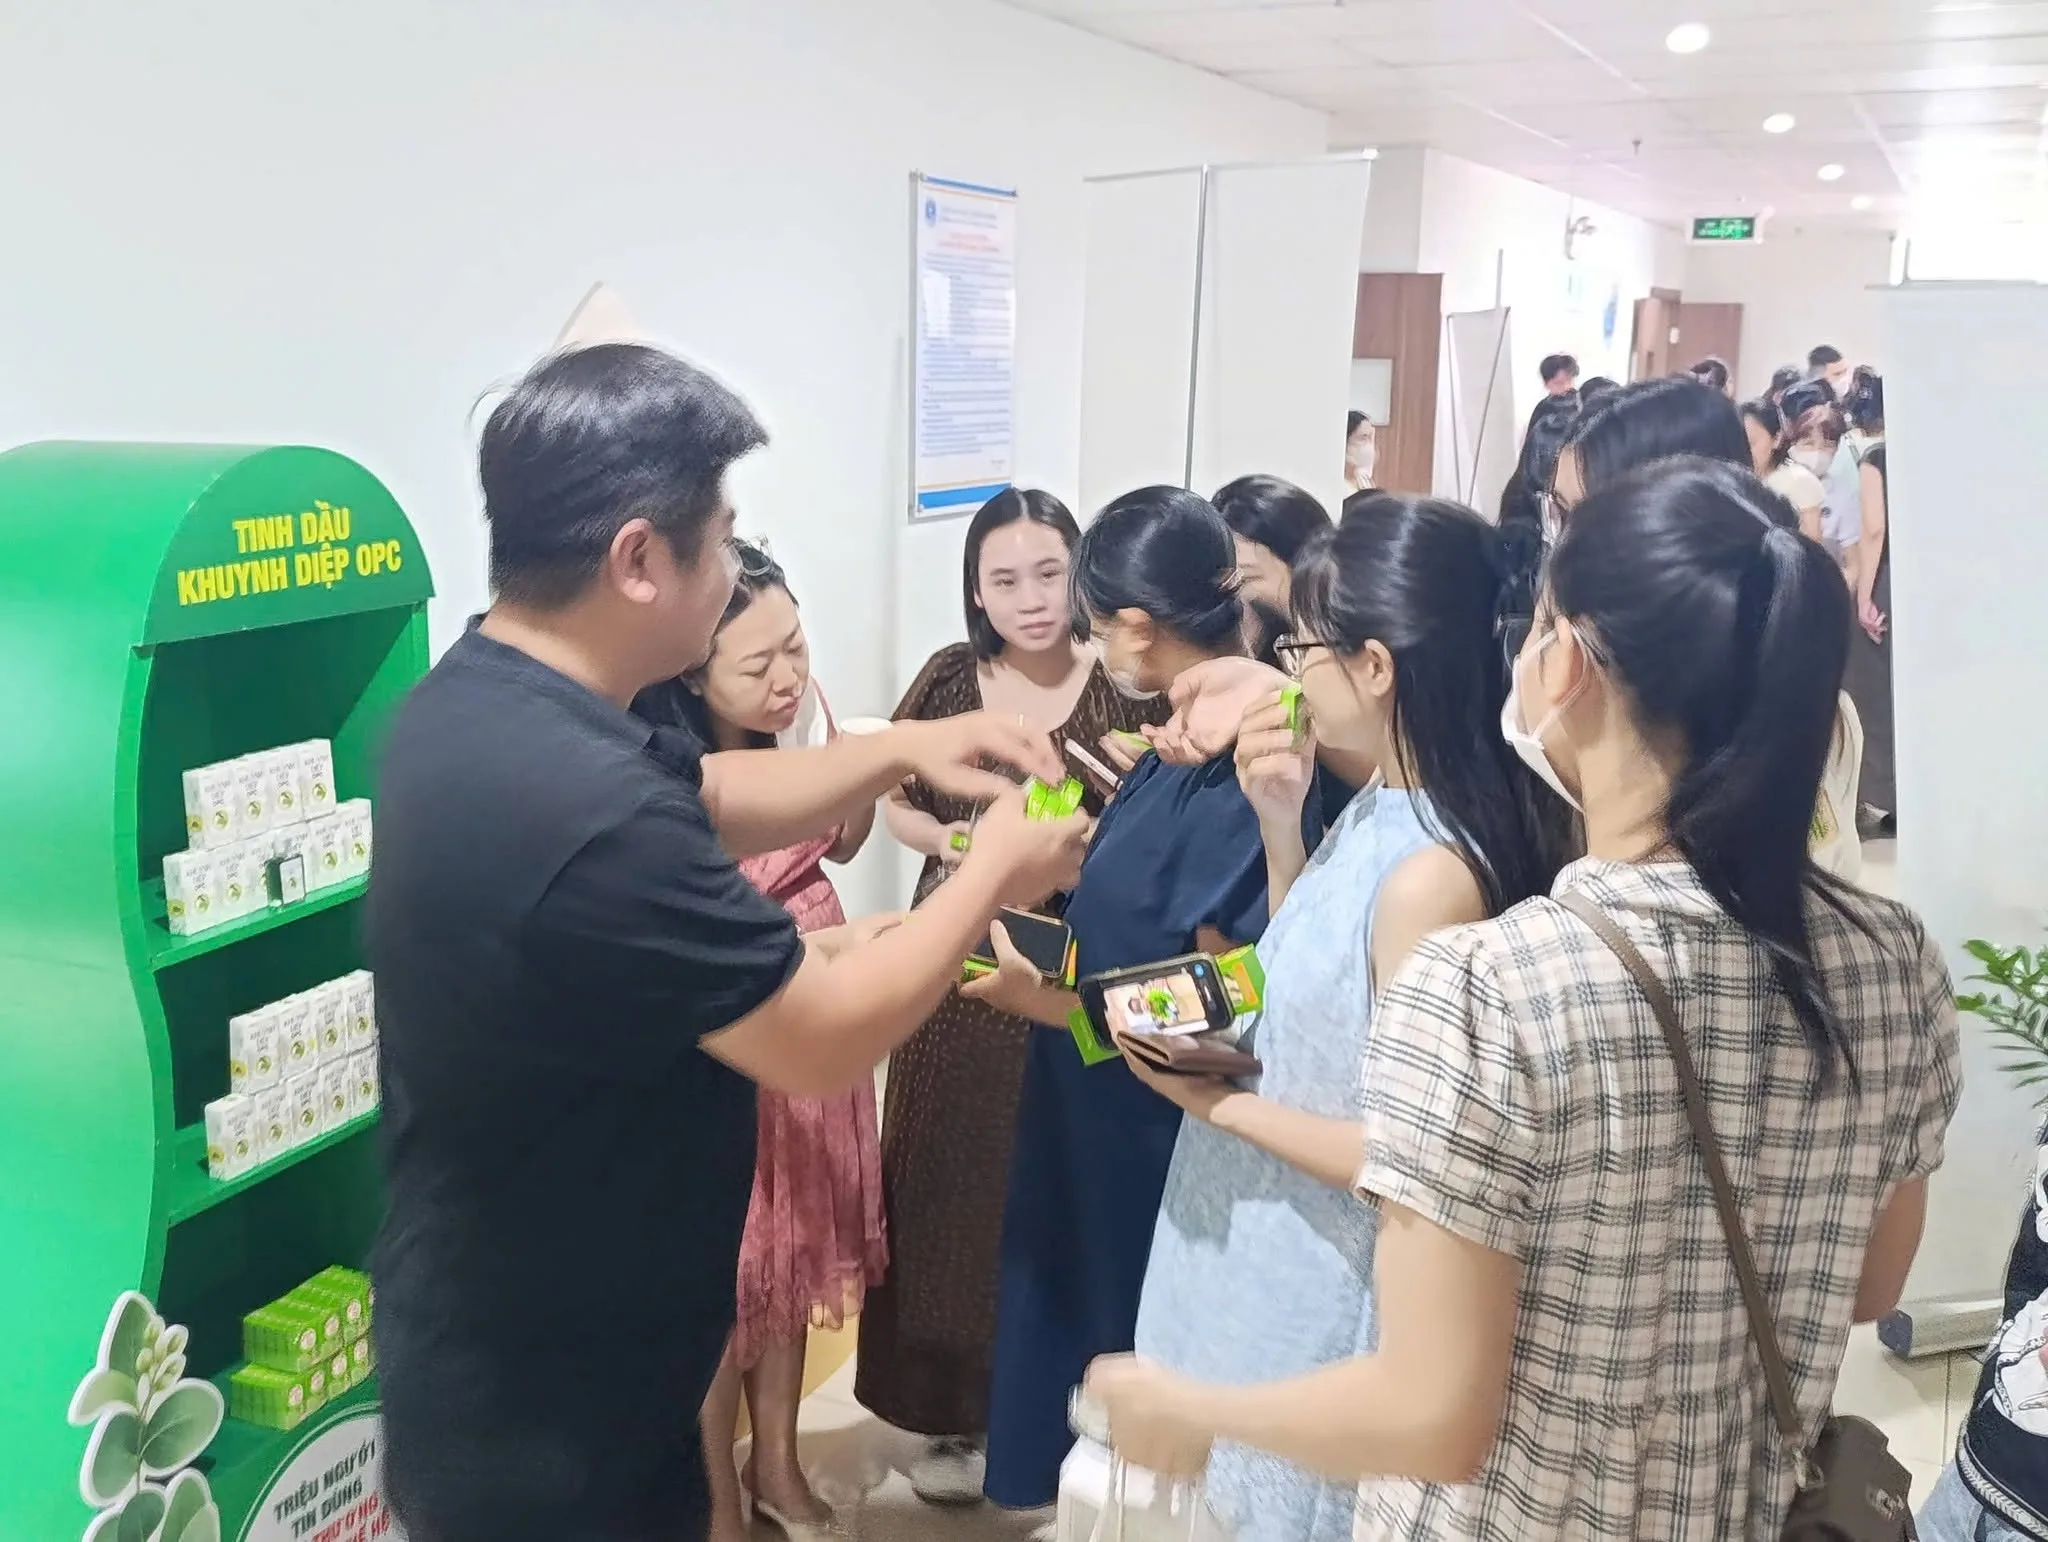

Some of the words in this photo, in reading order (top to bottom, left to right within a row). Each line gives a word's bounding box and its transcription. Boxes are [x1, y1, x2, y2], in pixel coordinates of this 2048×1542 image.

[232, 514, 294, 554] TINH
[301, 499, 351, 546] DẦU
[176, 556, 289, 606] KHUYNH
[294, 541, 350, 590] DIỆP
[355, 539, 402, 577] OPC
[291, 1506, 318, 1540] TIN
